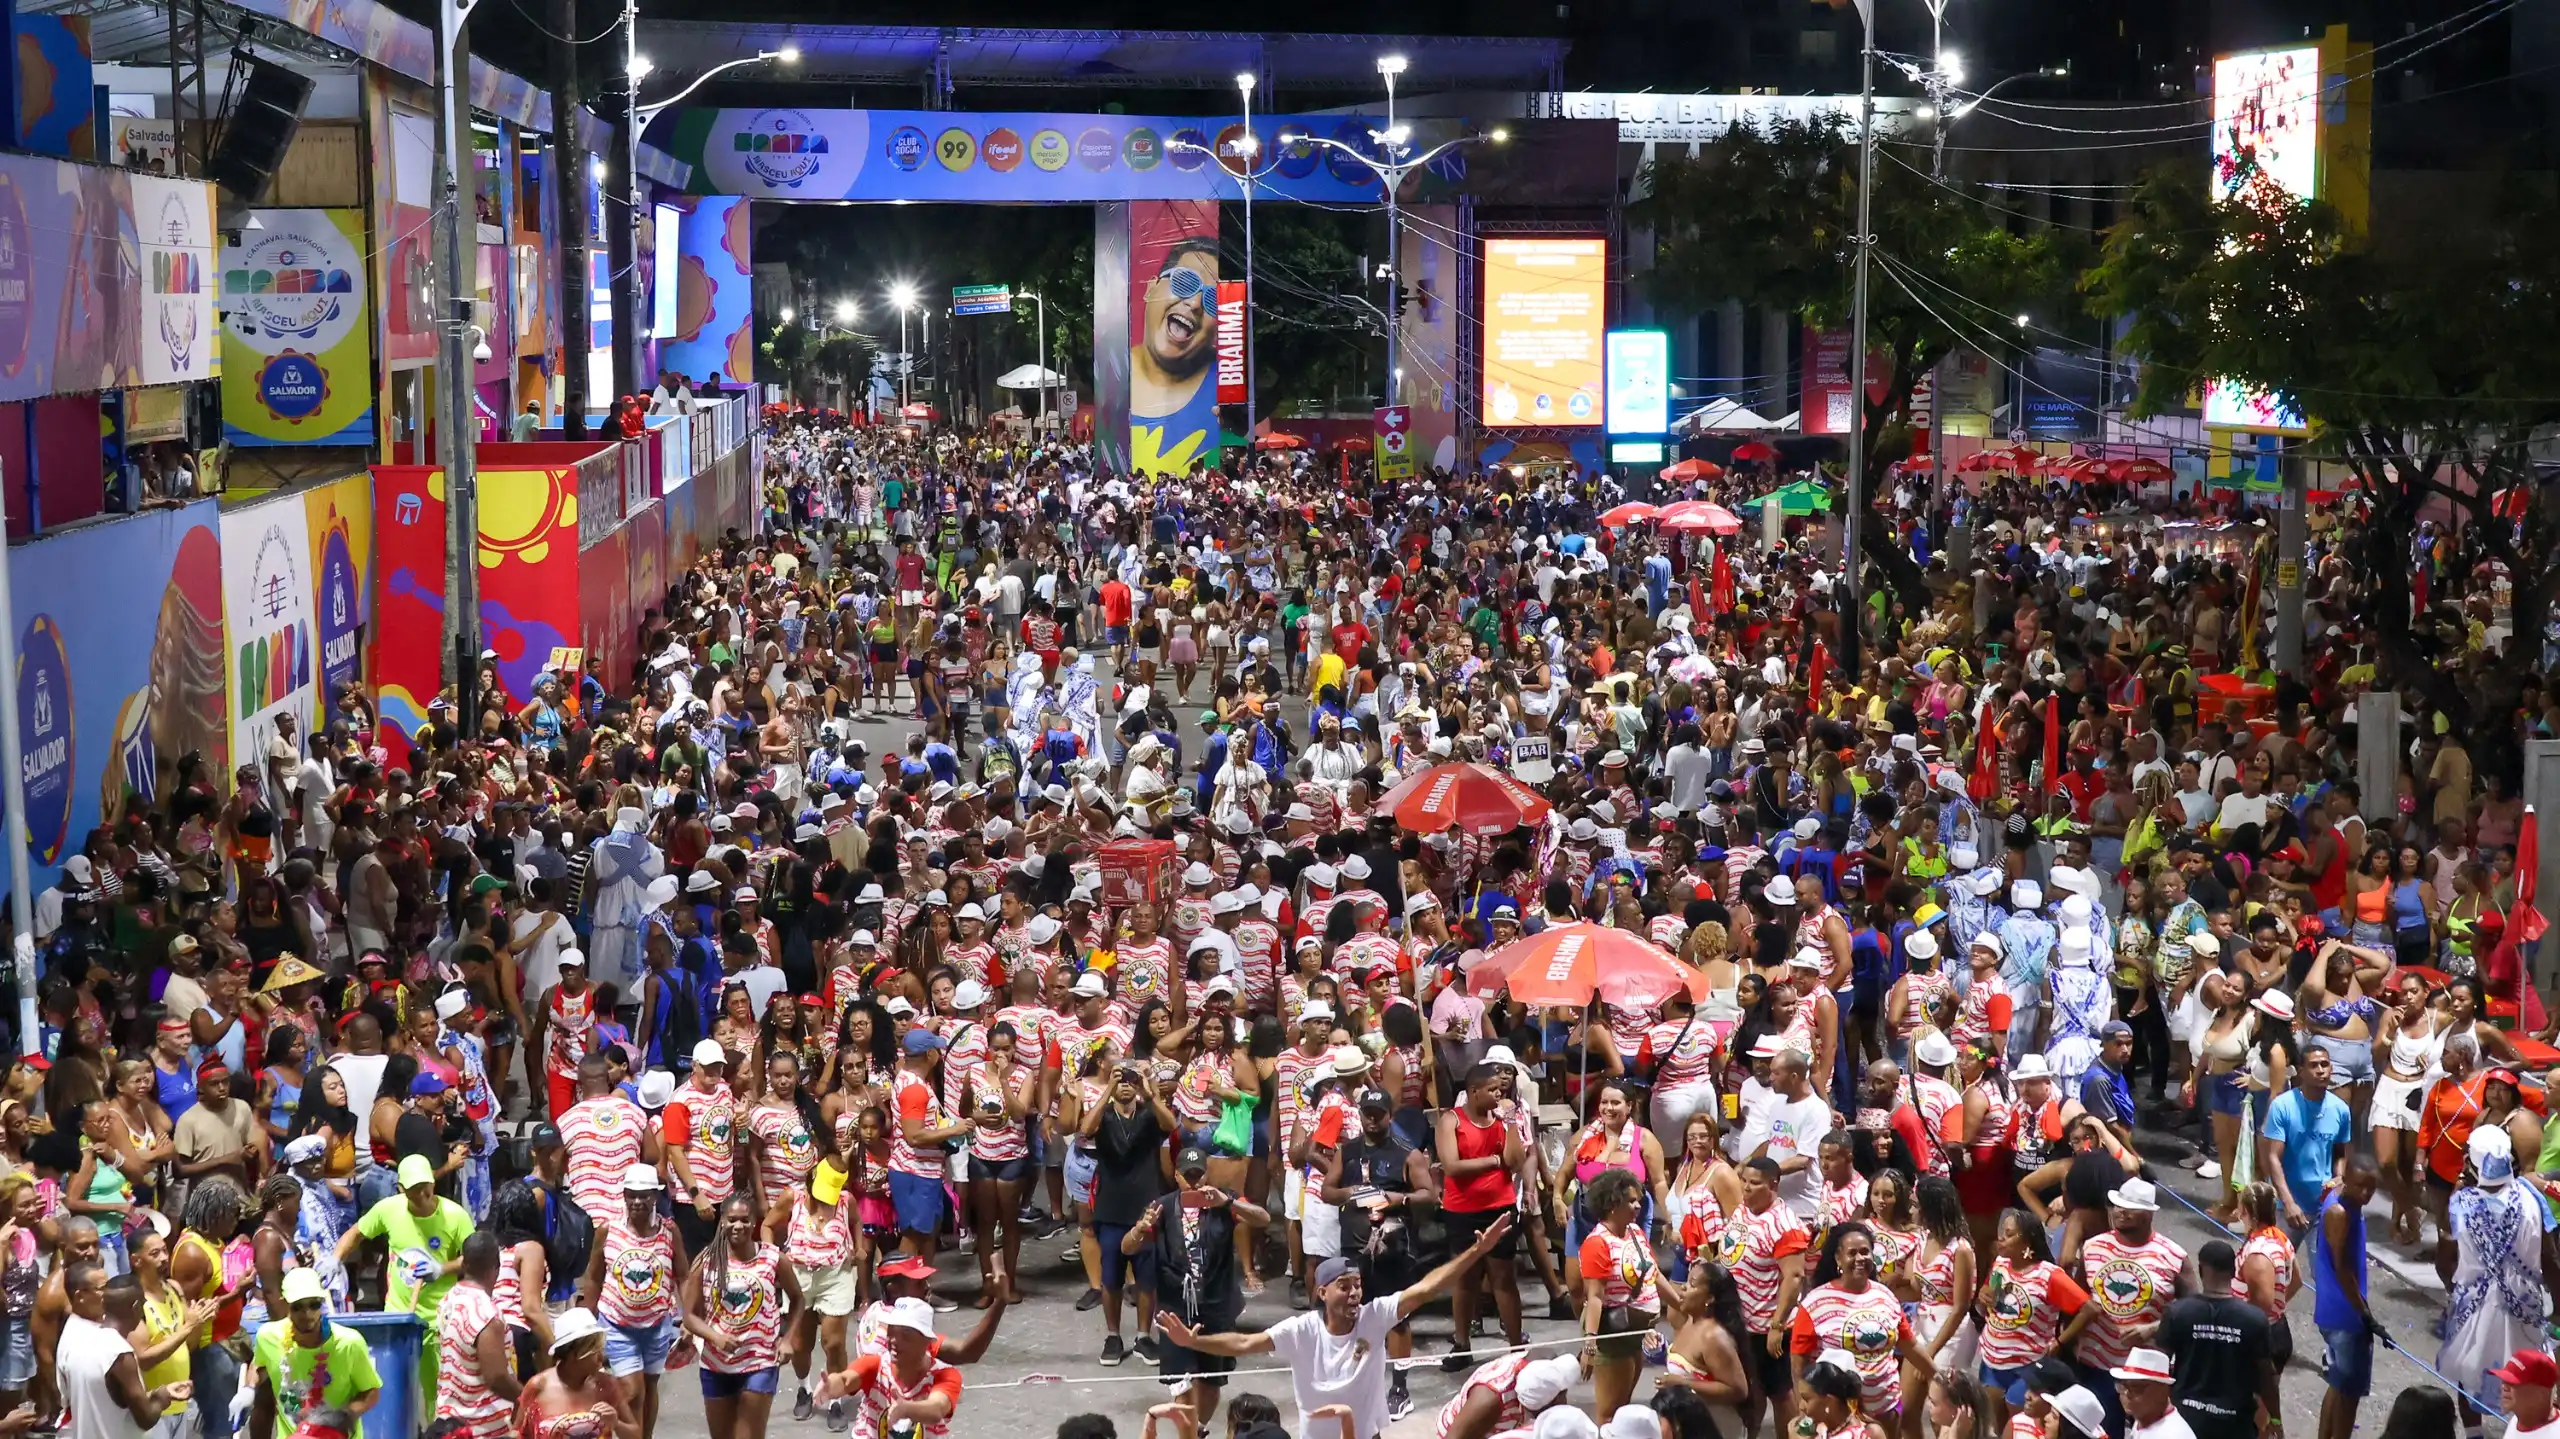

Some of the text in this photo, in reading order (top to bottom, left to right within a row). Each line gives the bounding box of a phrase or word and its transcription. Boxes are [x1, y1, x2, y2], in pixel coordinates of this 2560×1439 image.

[128, 128, 176, 142] Salvador
[898, 137, 918, 146] CLUB
[160, 146, 176, 159] TV
[895, 145, 922, 154] SOCIAL
[943, 141, 968, 158] 99
[1219, 143, 1259, 158] BRAA
[1334, 153, 1375, 163] SALVOR
[752, 155, 812, 179] NASCEU AQUI
[246, 233, 328, 260] CARNAVAL SALVADOR
[251, 296, 329, 327] NASCEU AQUI
[1217, 300, 1244, 386] BRAHMA
[269, 385, 317, 396] SALVADOR
[2033, 403, 2047, 411] DE
[325, 629, 357, 669] SALVADOR
[1518, 744, 1547, 757] BAR
[23, 735, 67, 783] SALVADOR
[1421, 772, 1458, 814] BRAHMA
[1491, 770, 1536, 808] BRAHMA
[1477, 824, 1502, 834] BRAHMA
[1545, 934, 1588, 981] BRAHMA
[1126, 961, 1157, 975] MUTANTES
[2098, 1262, 2150, 1285] MUTANTES
